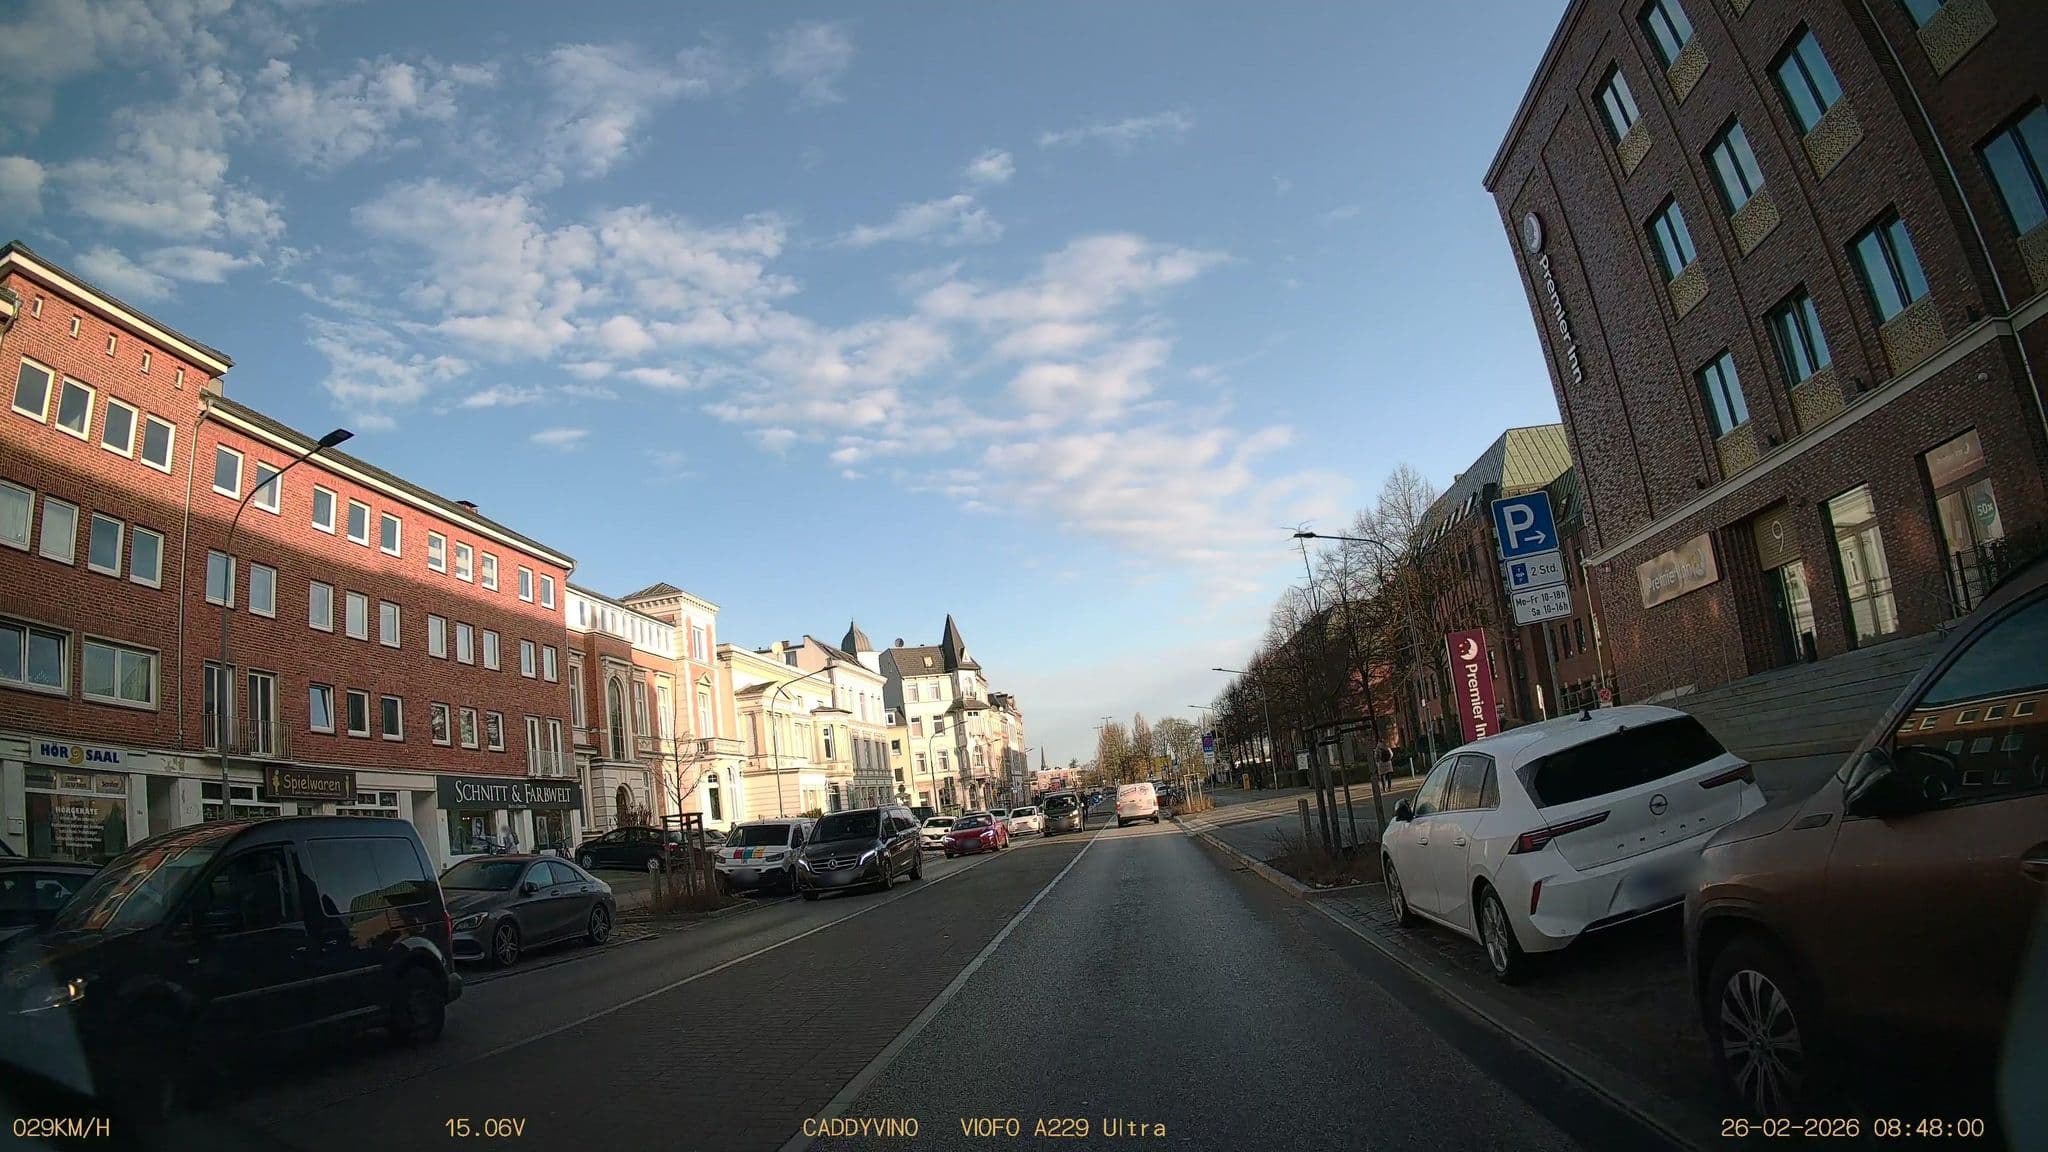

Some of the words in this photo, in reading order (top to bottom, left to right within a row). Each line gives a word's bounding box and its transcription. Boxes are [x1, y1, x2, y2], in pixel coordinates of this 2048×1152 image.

[1539, 253, 1572, 343] Premier
[1567, 344, 1583, 385] Inn
[1502, 503, 1534, 550] P
[1771, 520, 1784, 554] 9
[1530, 566, 1537, 577] 2
[1539, 563, 1559, 575] Std.
[1515, 595, 1538, 607] Mo-Fr
[1531, 607, 1541, 617] Sa
[1465, 663, 1485, 721] Premier
[40, 743, 69, 759] HÖR
[85, 749, 120, 763] SAAL
[282, 774, 341, 795] Spielwaren
[455, 780, 508, 803] SCHNITT
[511, 784, 522, 803] &
[524, 783, 572, 804] FARBWELT
